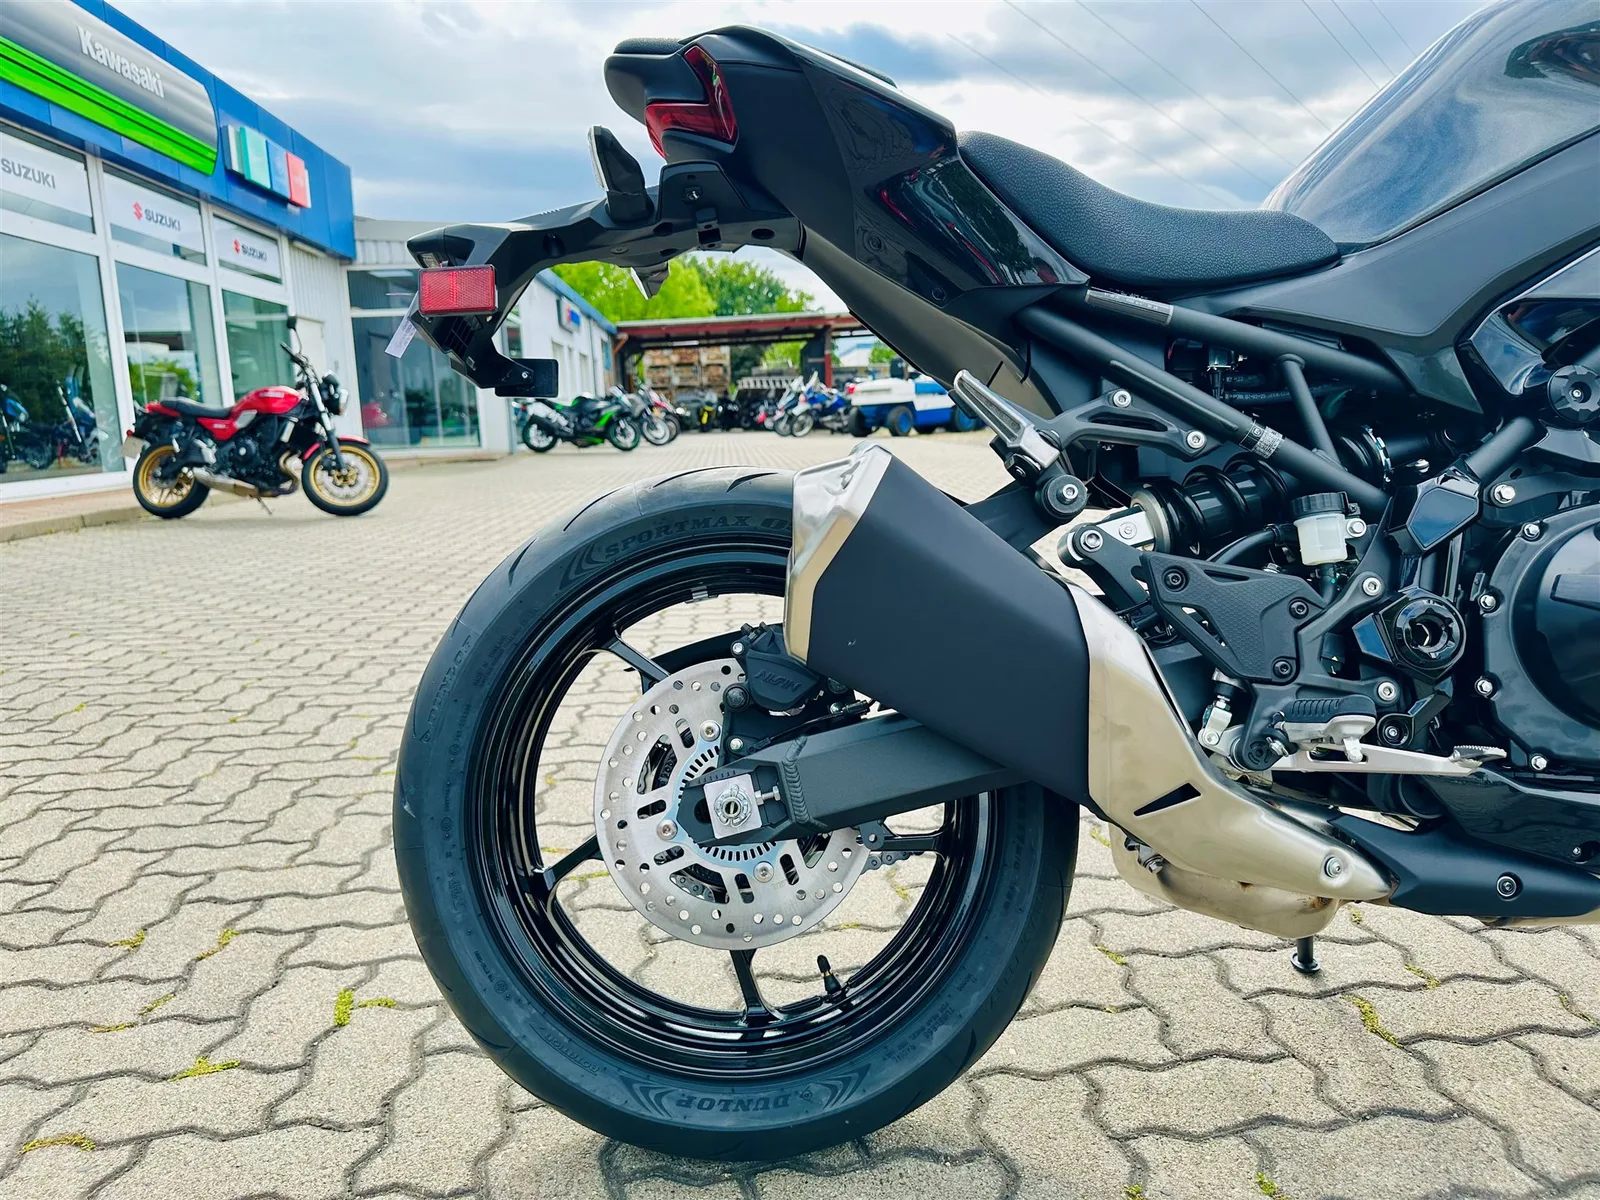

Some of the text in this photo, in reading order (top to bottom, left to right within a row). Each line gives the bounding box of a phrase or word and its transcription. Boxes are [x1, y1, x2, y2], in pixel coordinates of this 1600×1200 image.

[76, 25, 165, 99] Kawasaki
[1, 157, 56, 190] SUZUKI
[144, 208, 181, 233] SUZUKI
[241, 244, 268, 262] SUZUKI
[605, 515, 752, 559] SPORTMAX
[427, 633, 472, 728] DUNLOP
[675, 1094, 791, 1113] DUNLOP
